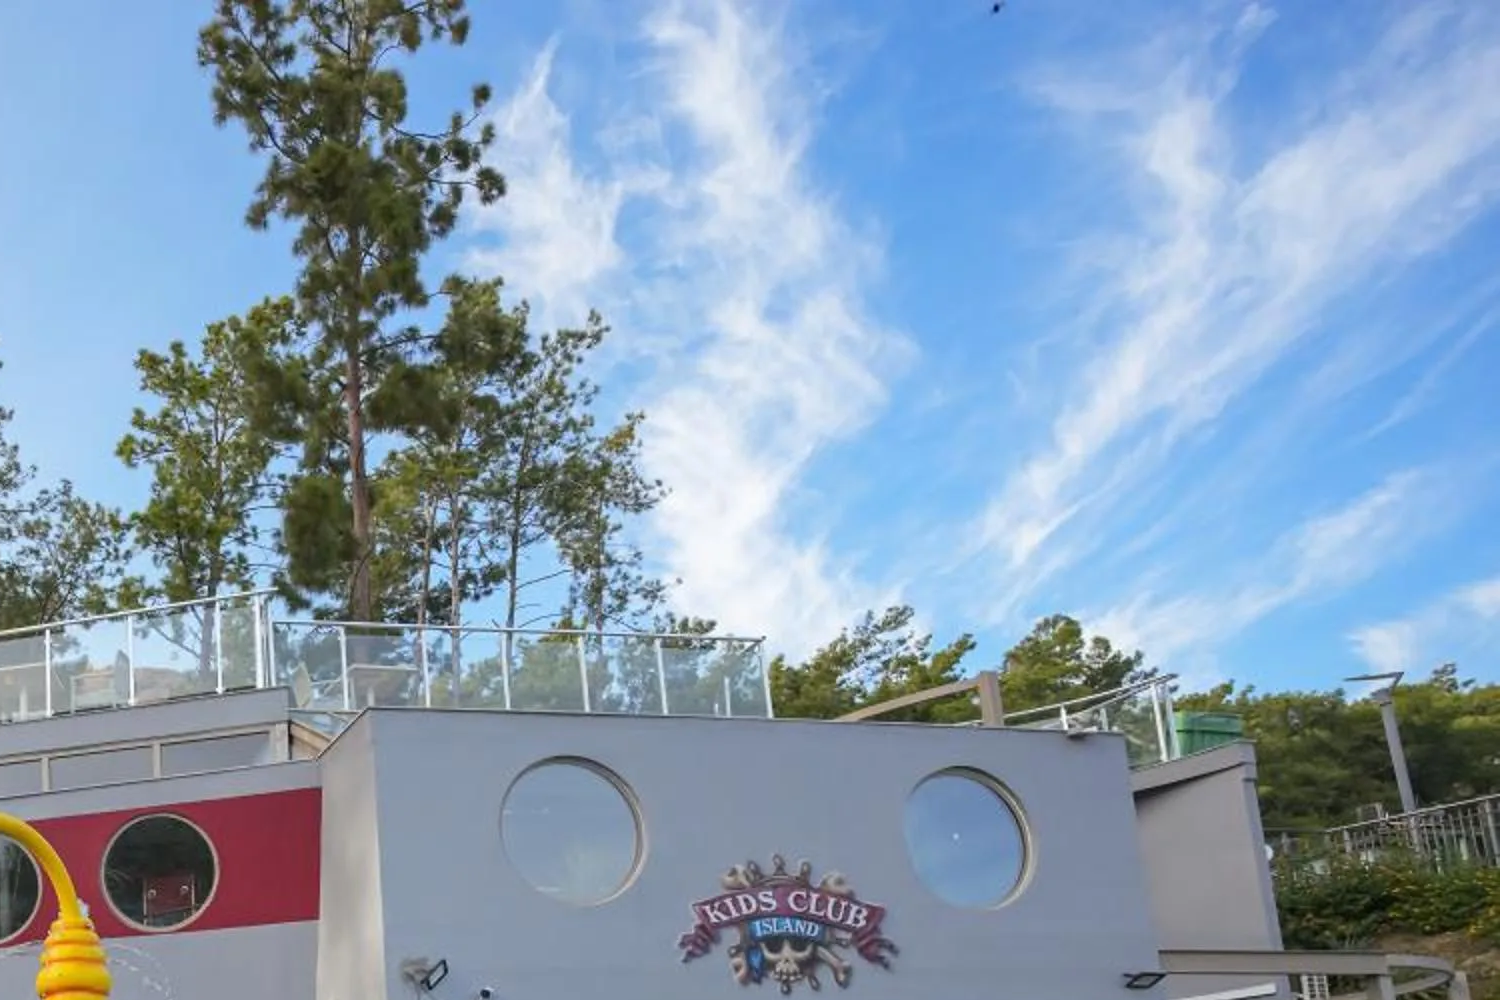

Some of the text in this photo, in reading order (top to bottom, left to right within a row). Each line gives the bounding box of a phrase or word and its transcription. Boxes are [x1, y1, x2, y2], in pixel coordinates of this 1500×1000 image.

[704, 890, 869, 928] KIDS CLUB
[755, 917, 820, 937] ISLAND
